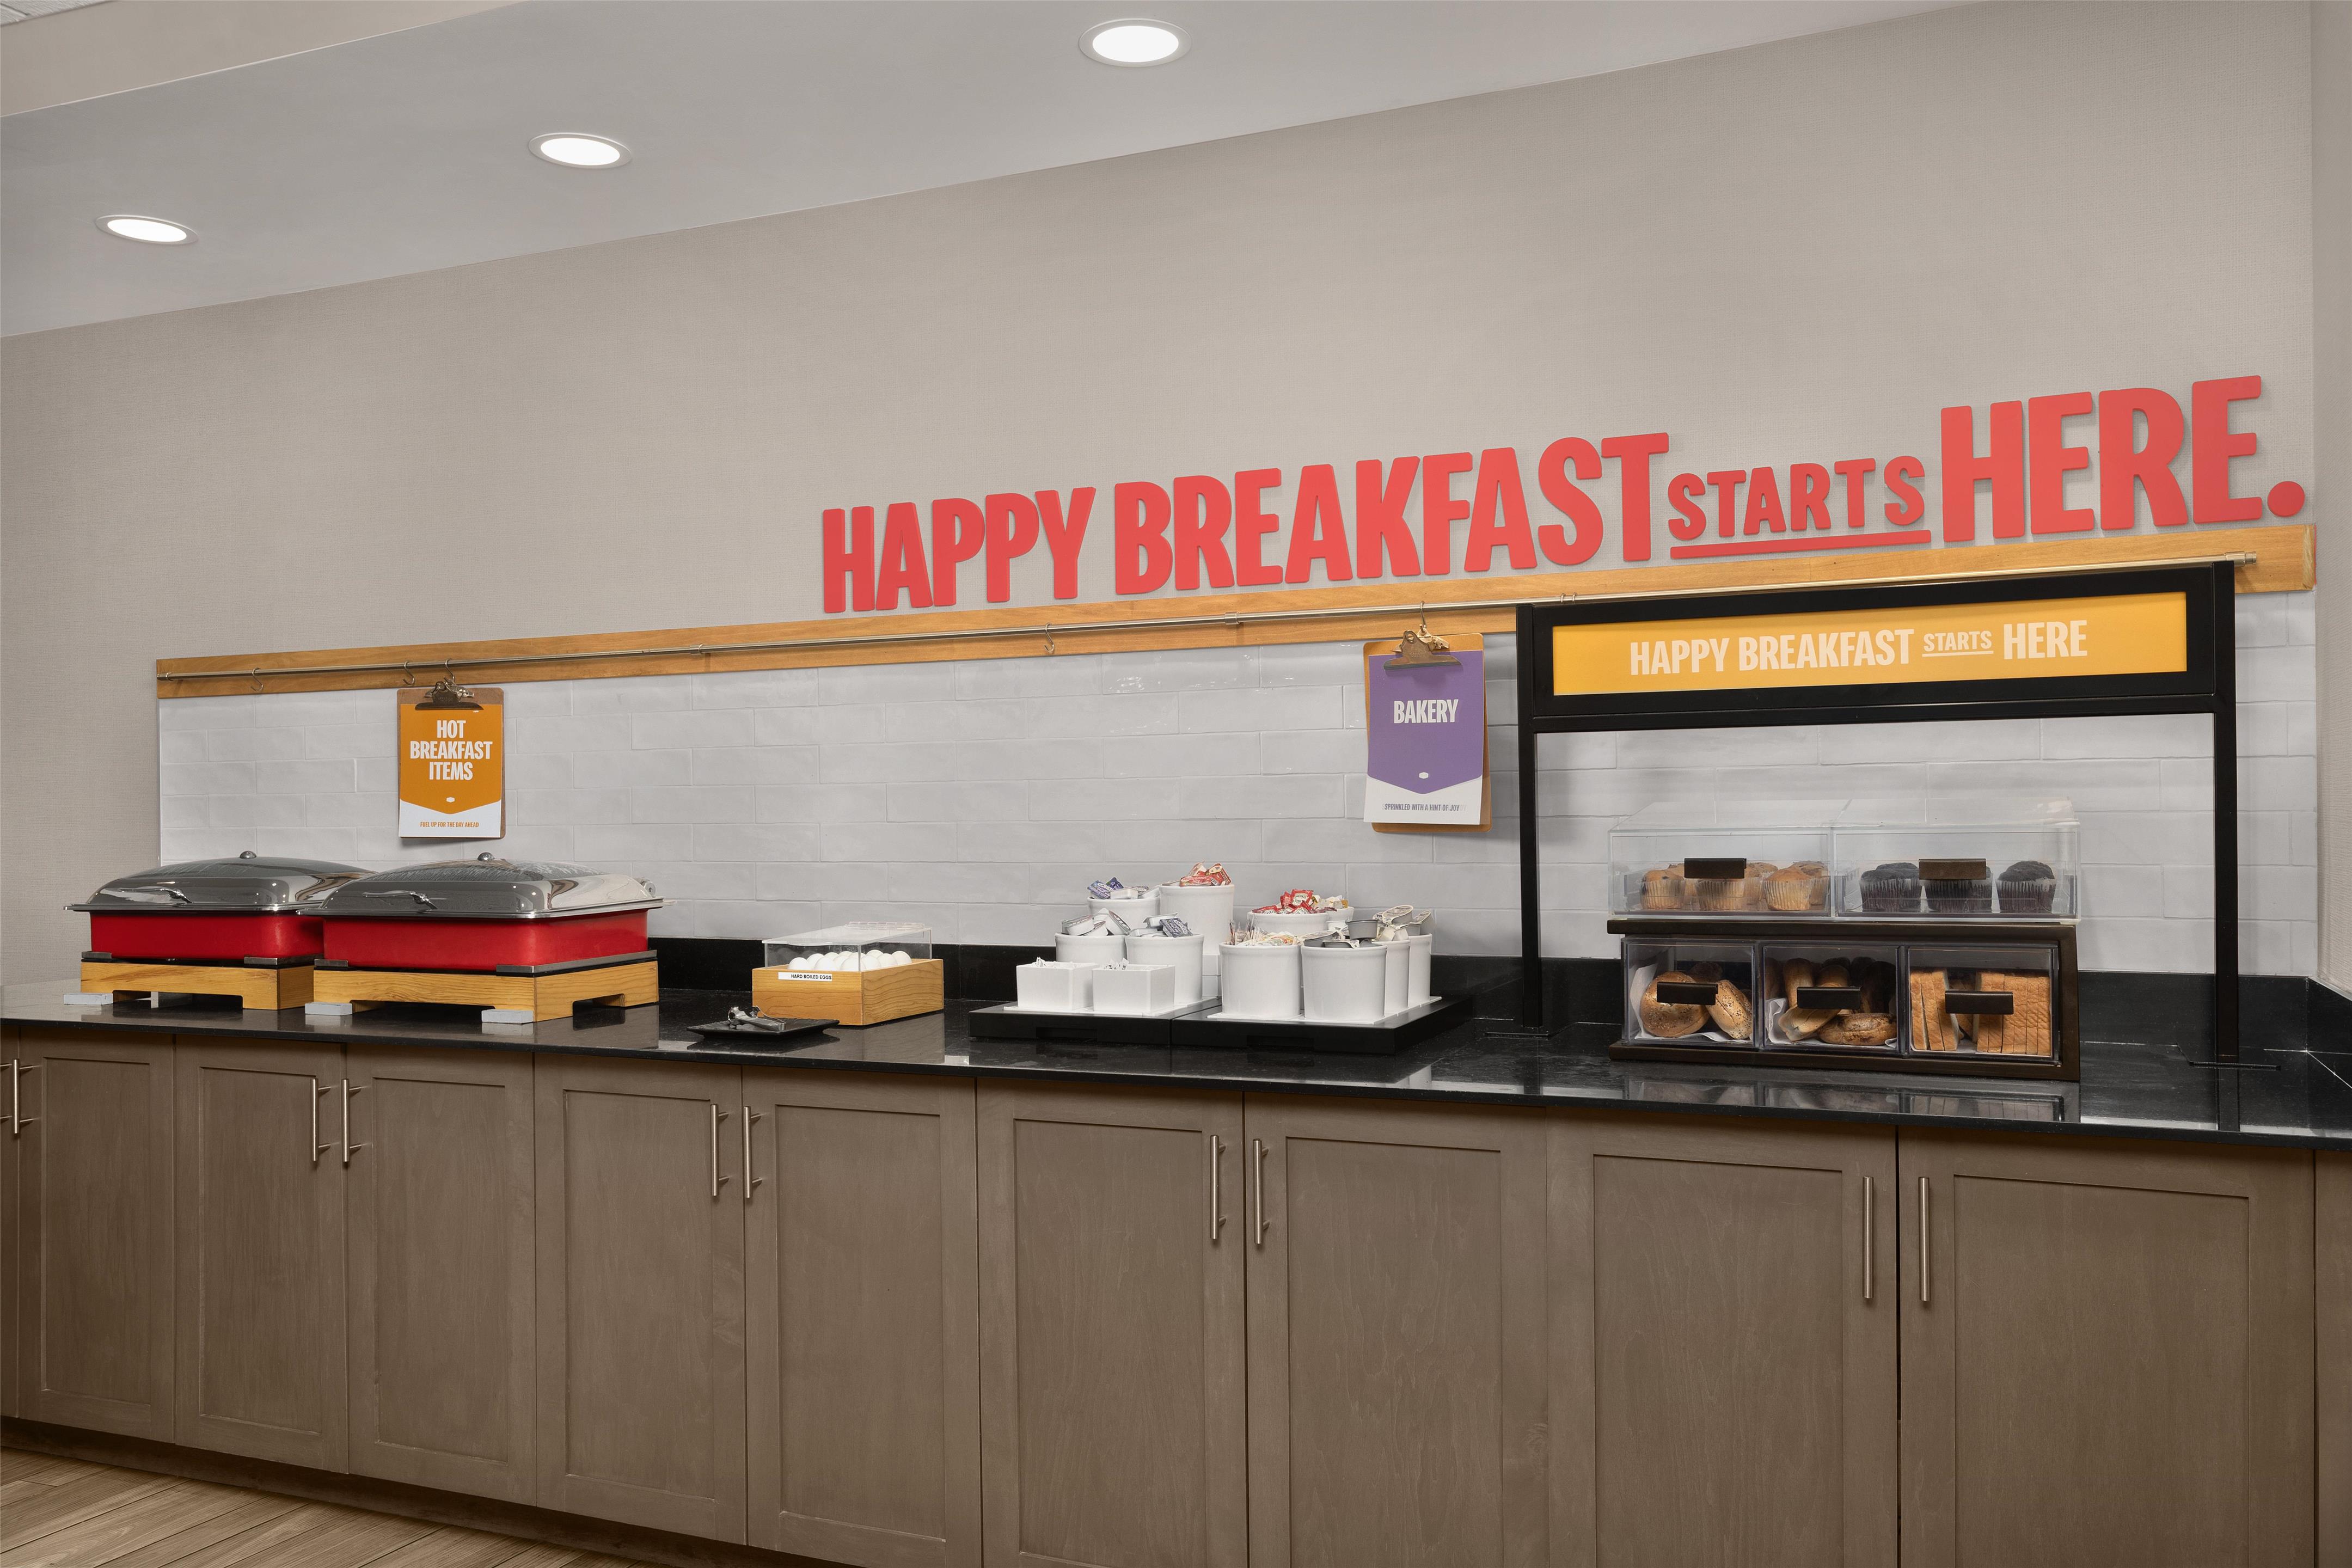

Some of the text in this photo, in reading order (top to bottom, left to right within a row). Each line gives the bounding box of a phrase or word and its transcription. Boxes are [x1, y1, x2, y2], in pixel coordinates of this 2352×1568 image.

[823, 375, 2305, 614] HAPPY BREAKFAST STARTS HERE.
[1630, 620, 2088, 676] HAPPY BREAKFAST STARTS HERE
[1394, 699, 1459, 724] BAKERY
[437, 720, 466, 739] HOT
[410, 741, 493, 759] BREAKFAST
[429, 762, 473, 781] ITEMS
